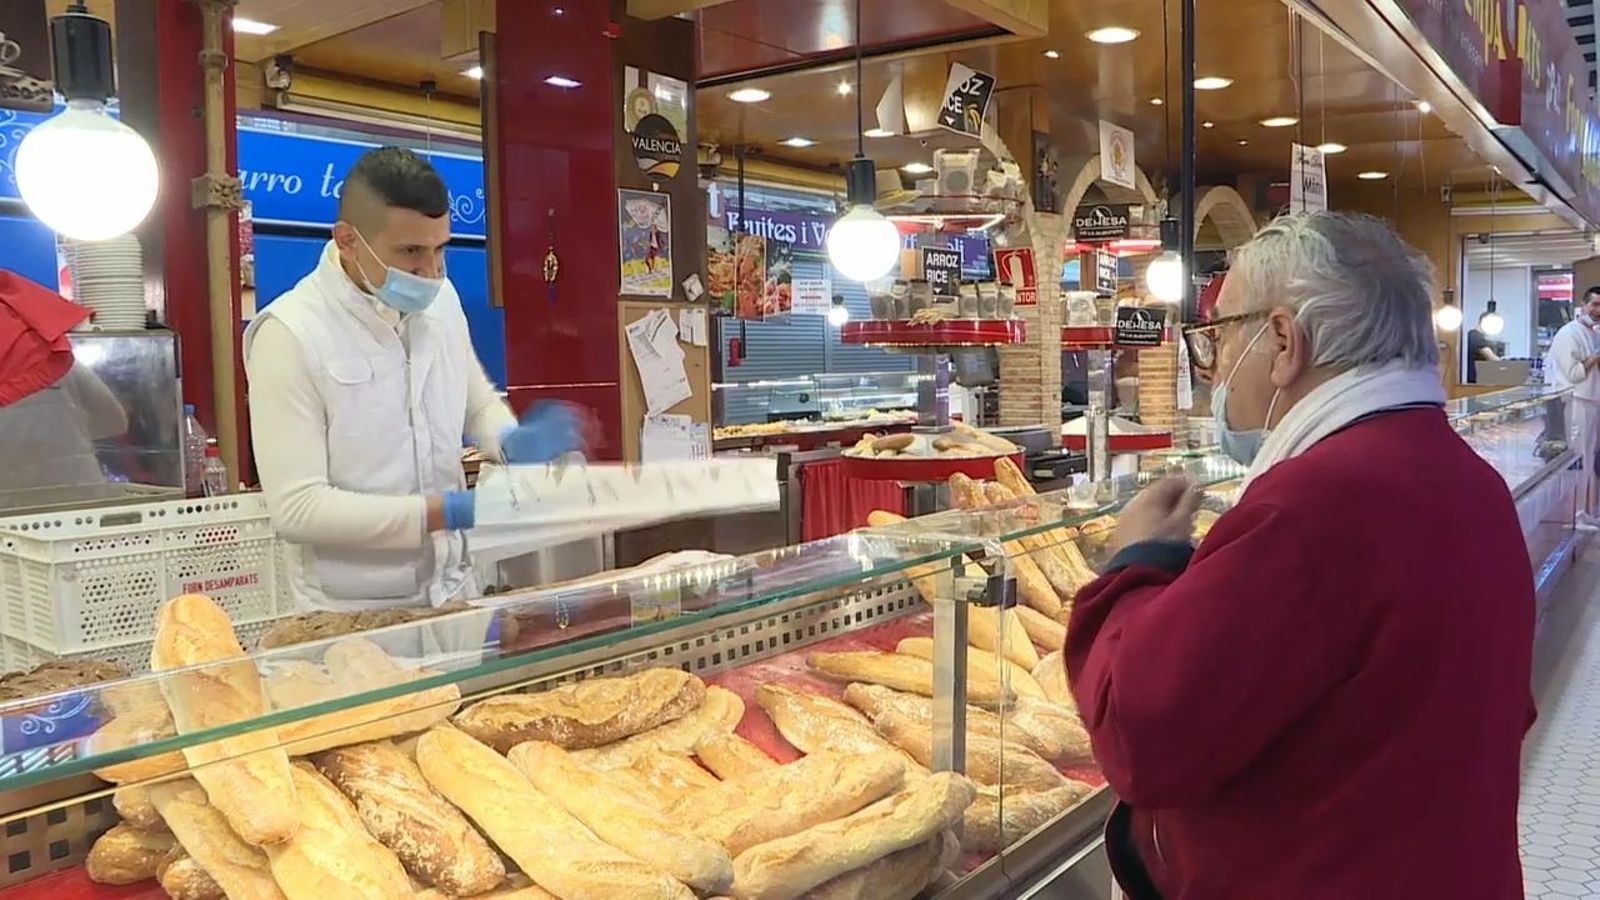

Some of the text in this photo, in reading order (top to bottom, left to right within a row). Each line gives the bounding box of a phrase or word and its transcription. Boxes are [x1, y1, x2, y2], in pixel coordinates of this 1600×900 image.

[960, 77, 984, 96] OZ
[632, 137, 682, 154] VALENCIA
[1076, 216, 1127, 228] DEHESA
[926, 252, 959, 268] ARROZ
[926, 269, 948, 283] RICE
[1118, 319, 1162, 331] DEHESA
[183, 573, 259, 595] FORN DESAMPARATS
